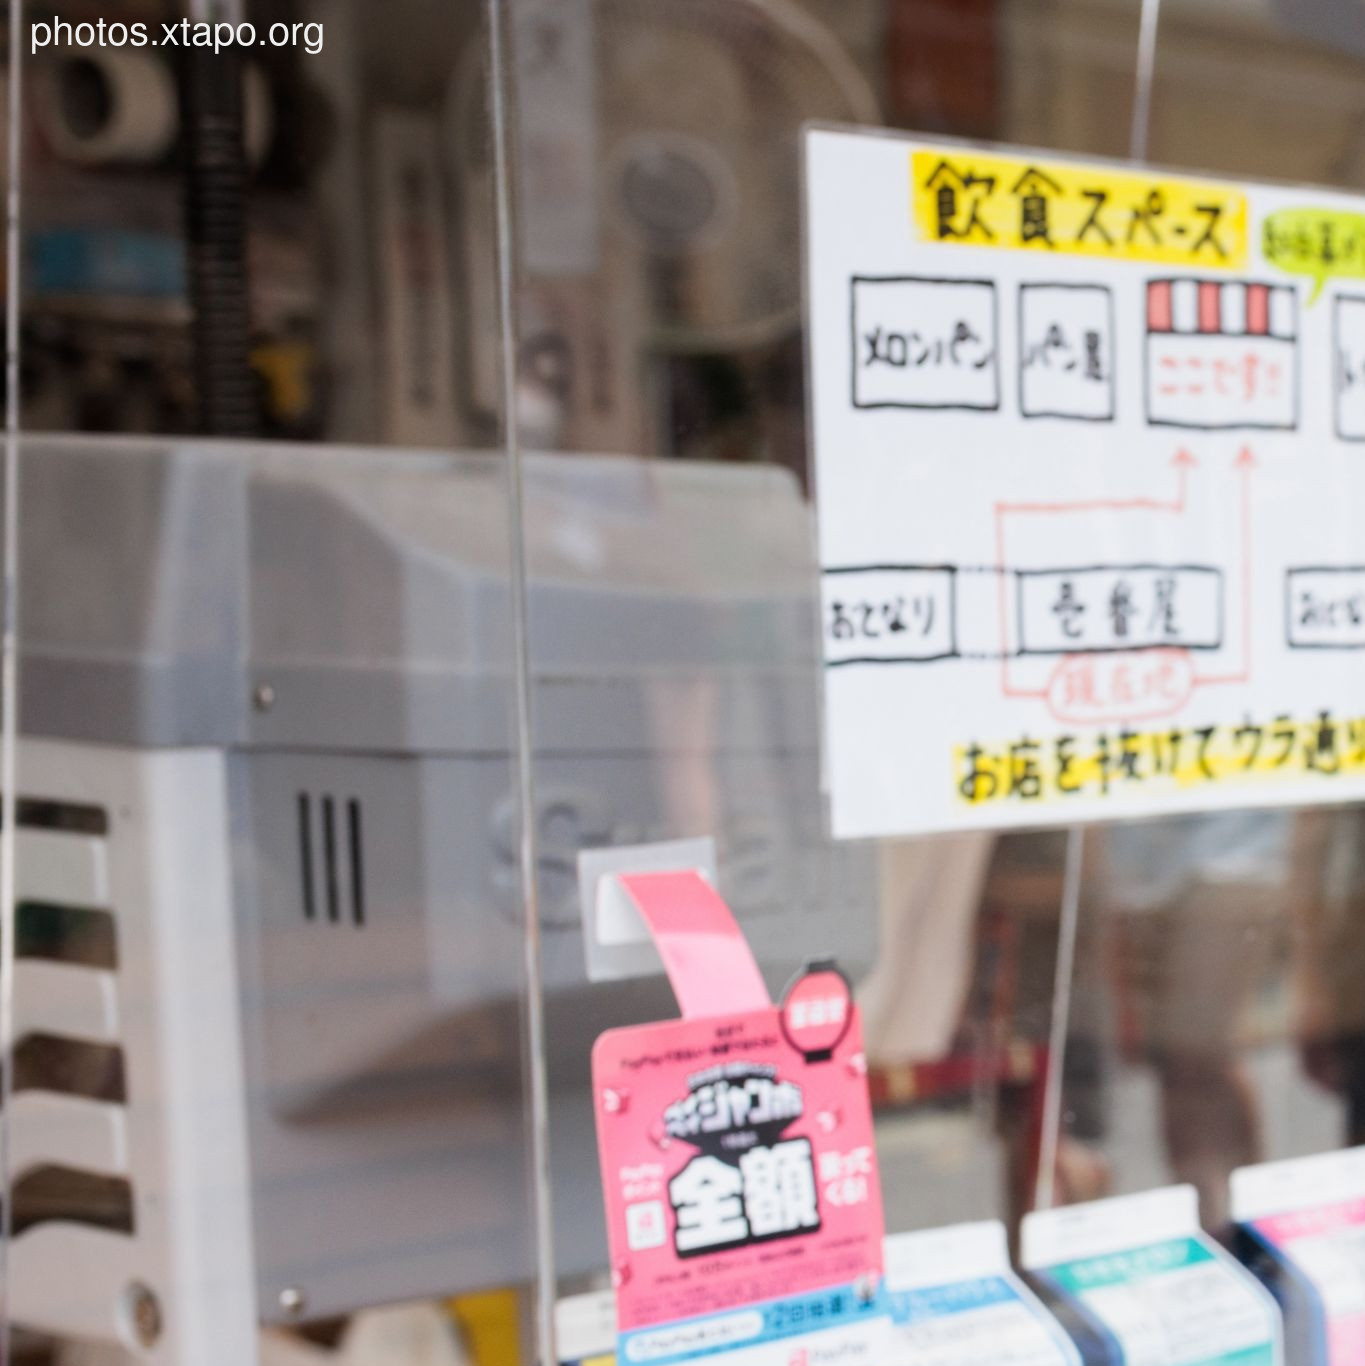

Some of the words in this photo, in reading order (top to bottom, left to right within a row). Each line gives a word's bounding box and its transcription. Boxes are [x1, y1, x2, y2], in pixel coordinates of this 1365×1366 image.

[923, 159, 1236, 261] 飲食スペース
[863, 318, 996, 372] メロンパン
[668, 1138, 820, 1253] 全額
